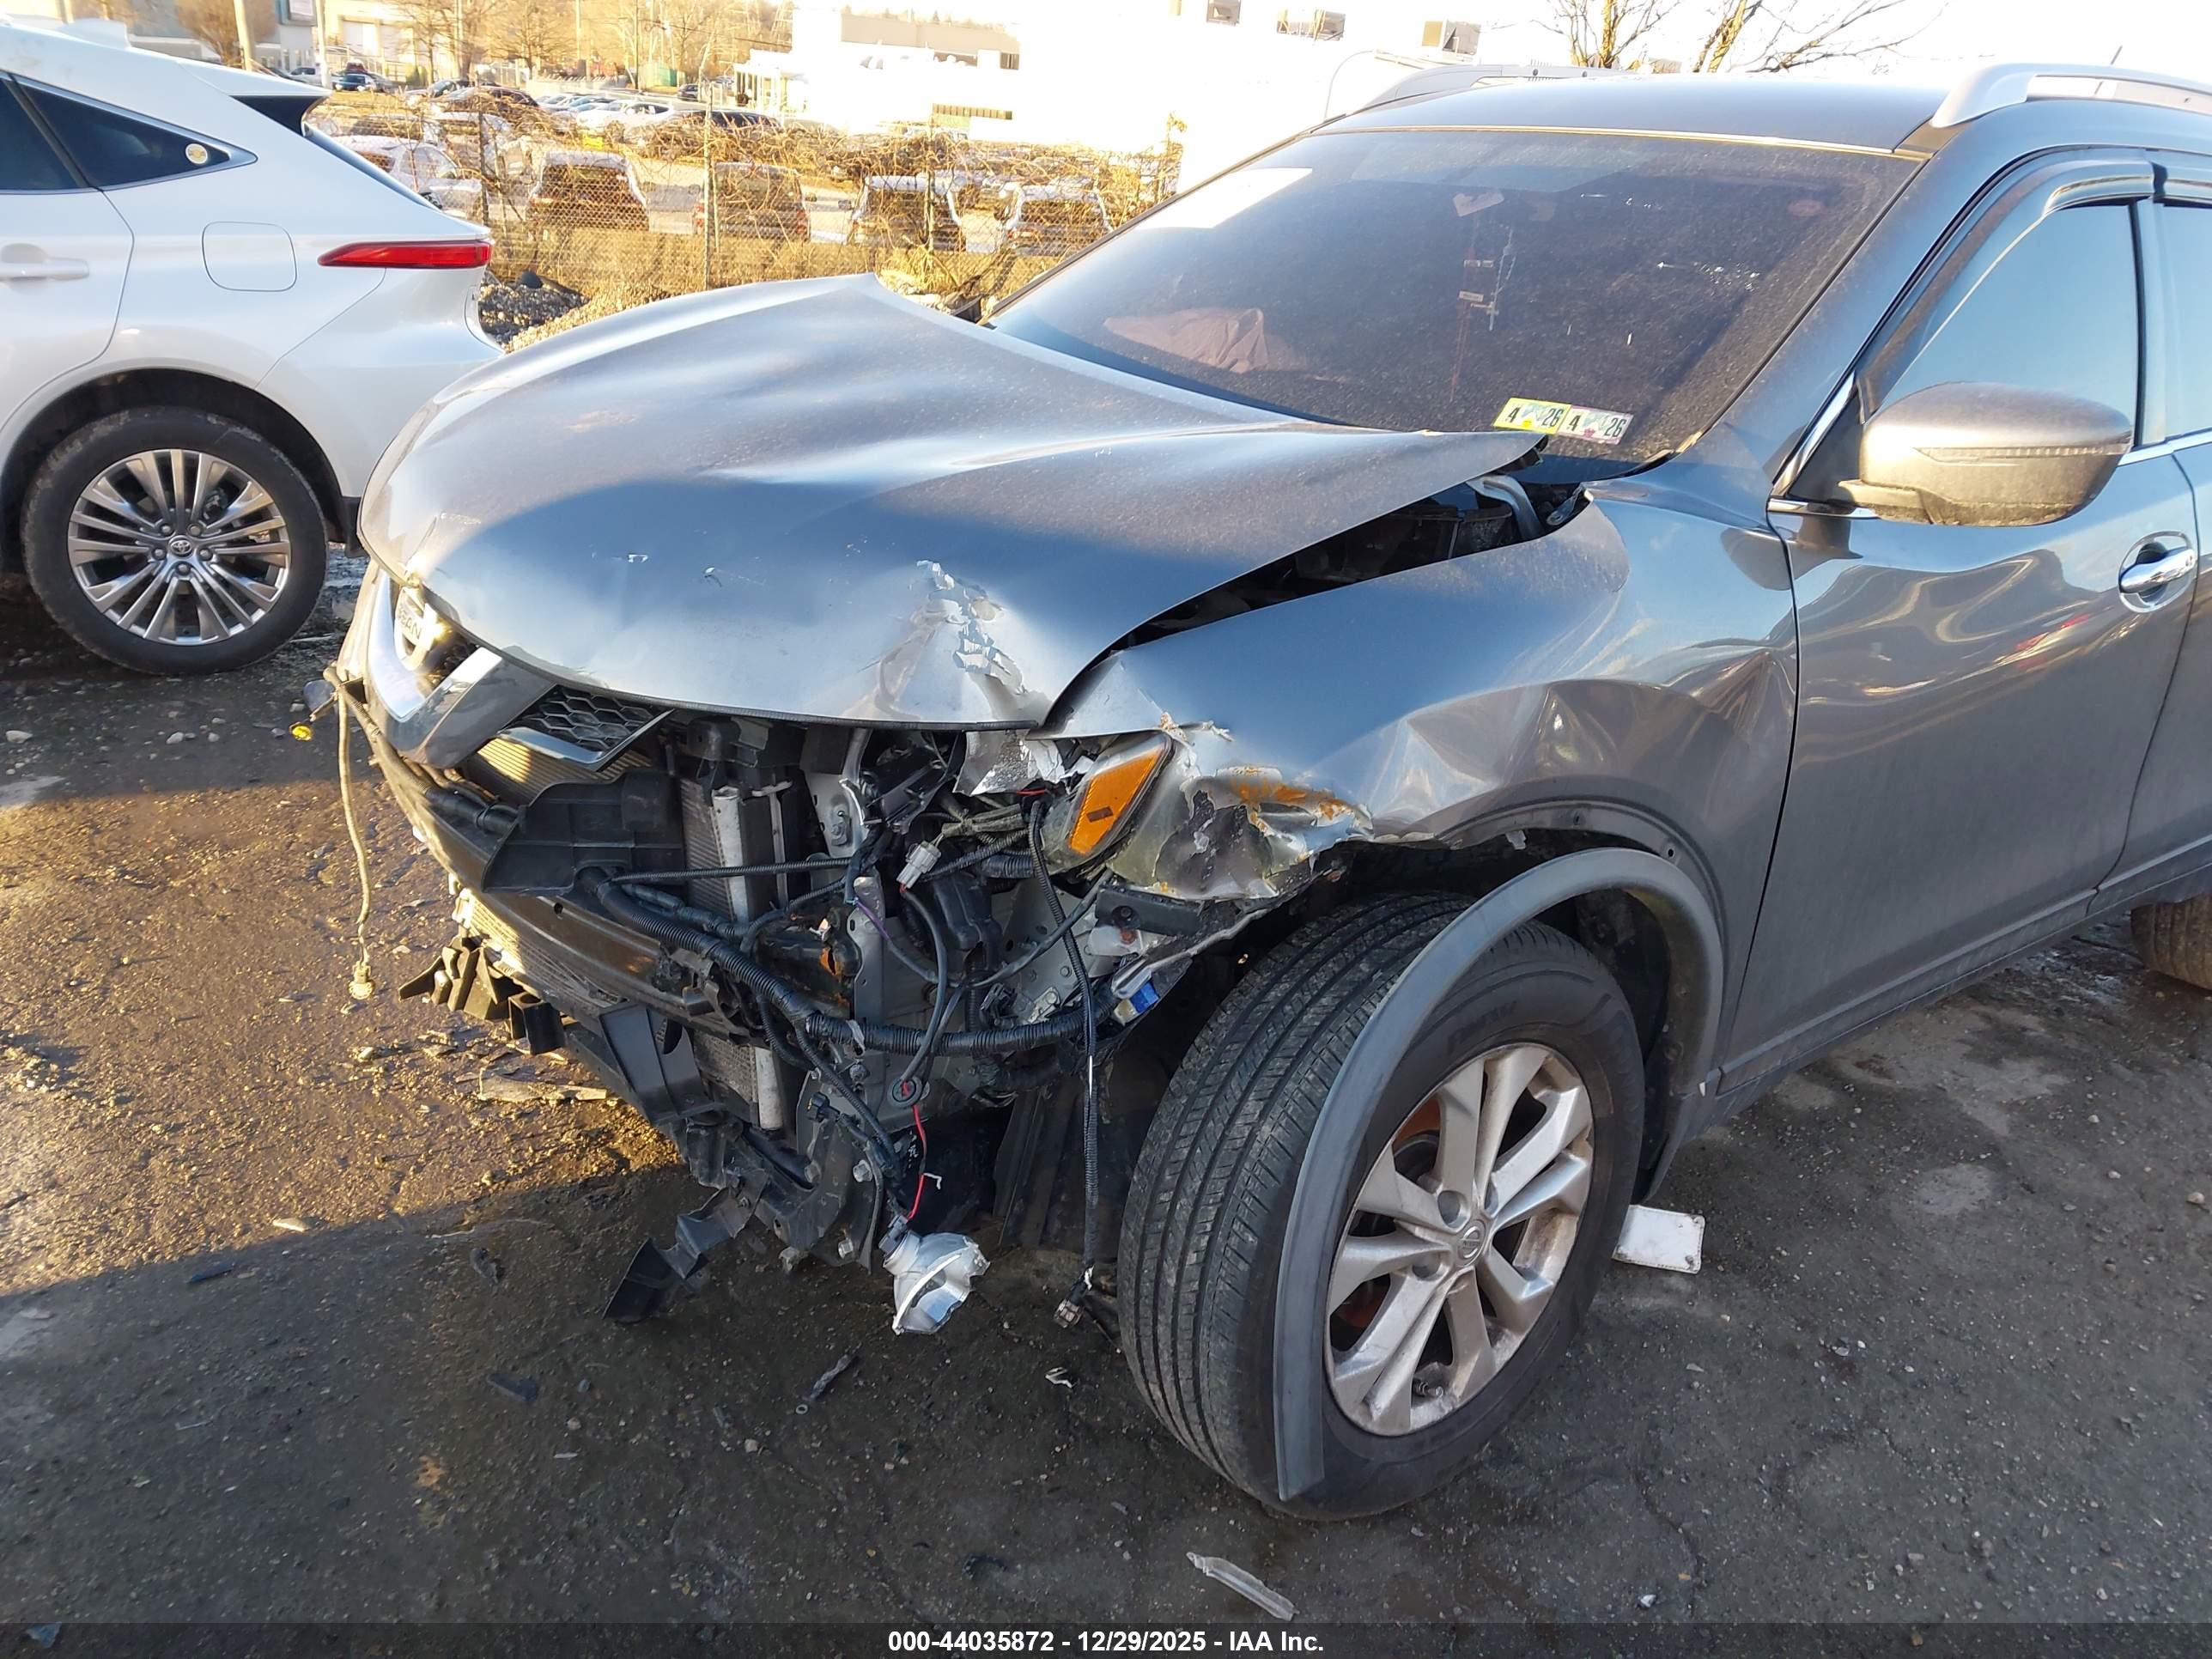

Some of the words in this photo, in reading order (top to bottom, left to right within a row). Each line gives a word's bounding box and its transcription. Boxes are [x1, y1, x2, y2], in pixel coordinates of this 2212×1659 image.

[1508, 406, 1522, 423] 4
[1541, 407, 1565, 428] 26
[1569, 415, 1581, 432] 4
[1603, 416, 1627, 438] 26
